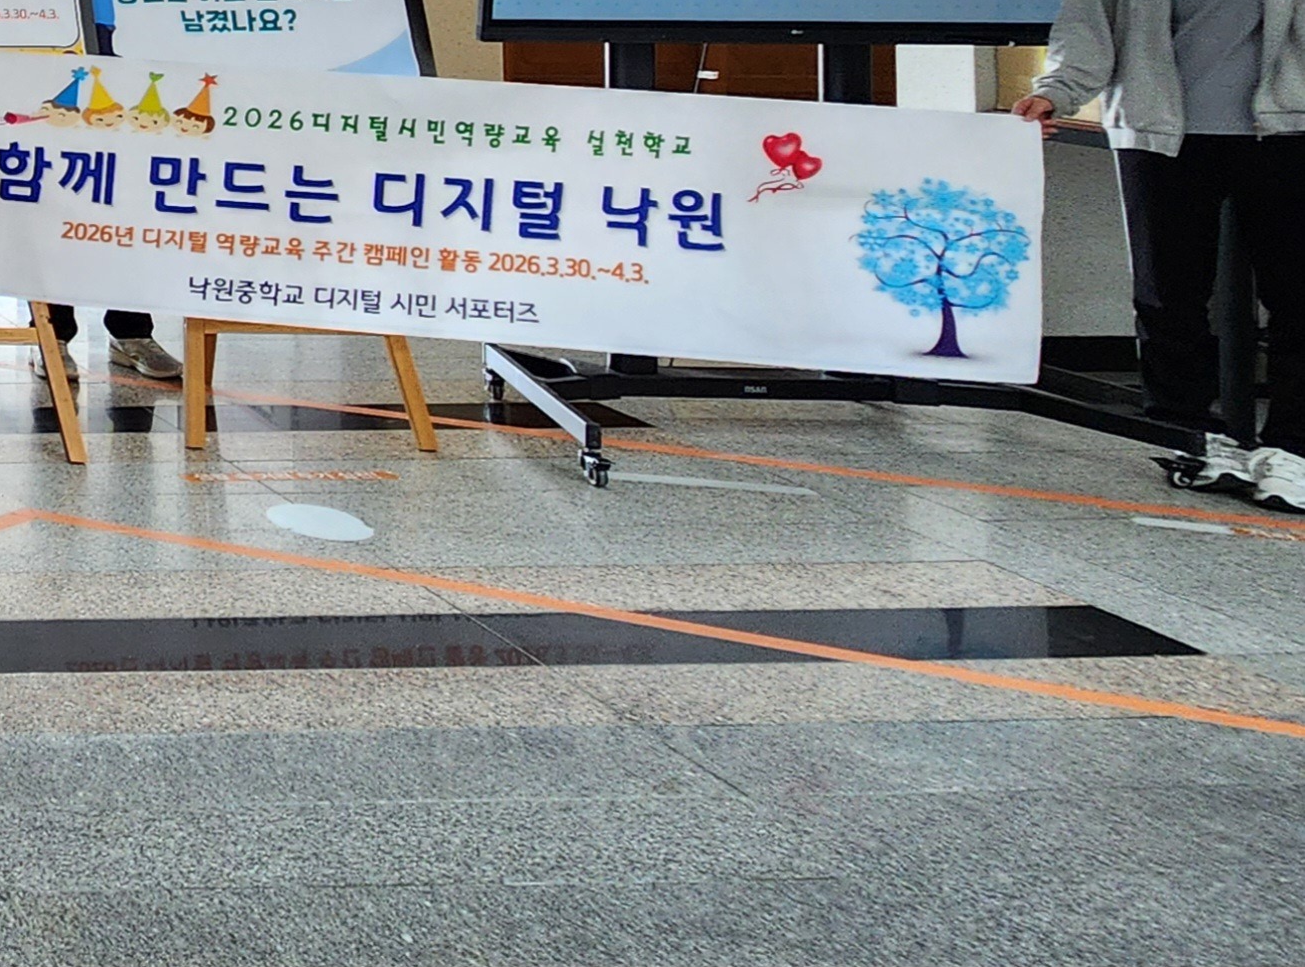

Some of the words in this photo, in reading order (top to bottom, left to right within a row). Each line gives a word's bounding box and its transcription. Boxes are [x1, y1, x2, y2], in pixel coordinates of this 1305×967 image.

[181, 8, 298, 33] 남겼나요?
[586, 128, 694, 159] 실천학교
[148, 155, 342, 225] 만드는
[373, 170, 563, 244] 디지털
[601, 186, 727, 253] 낙원
[60, 221, 135, 249] 2026년
[142, 227, 209, 254] 디지털
[215, 232, 306, 261] 역량교육
[312, 239, 357, 265] 주간
[363, 242, 431, 269] 캠페인
[438, 247, 483, 274] 활동
[488, 252, 650, 286] 2026.3.30.~4.3.
[188, 276, 305, 307] 낙원중학교
[313, 285, 382, 316] 디지털
[390, 290, 437, 320] 시민
[445, 297, 540, 326] 서포터즈
